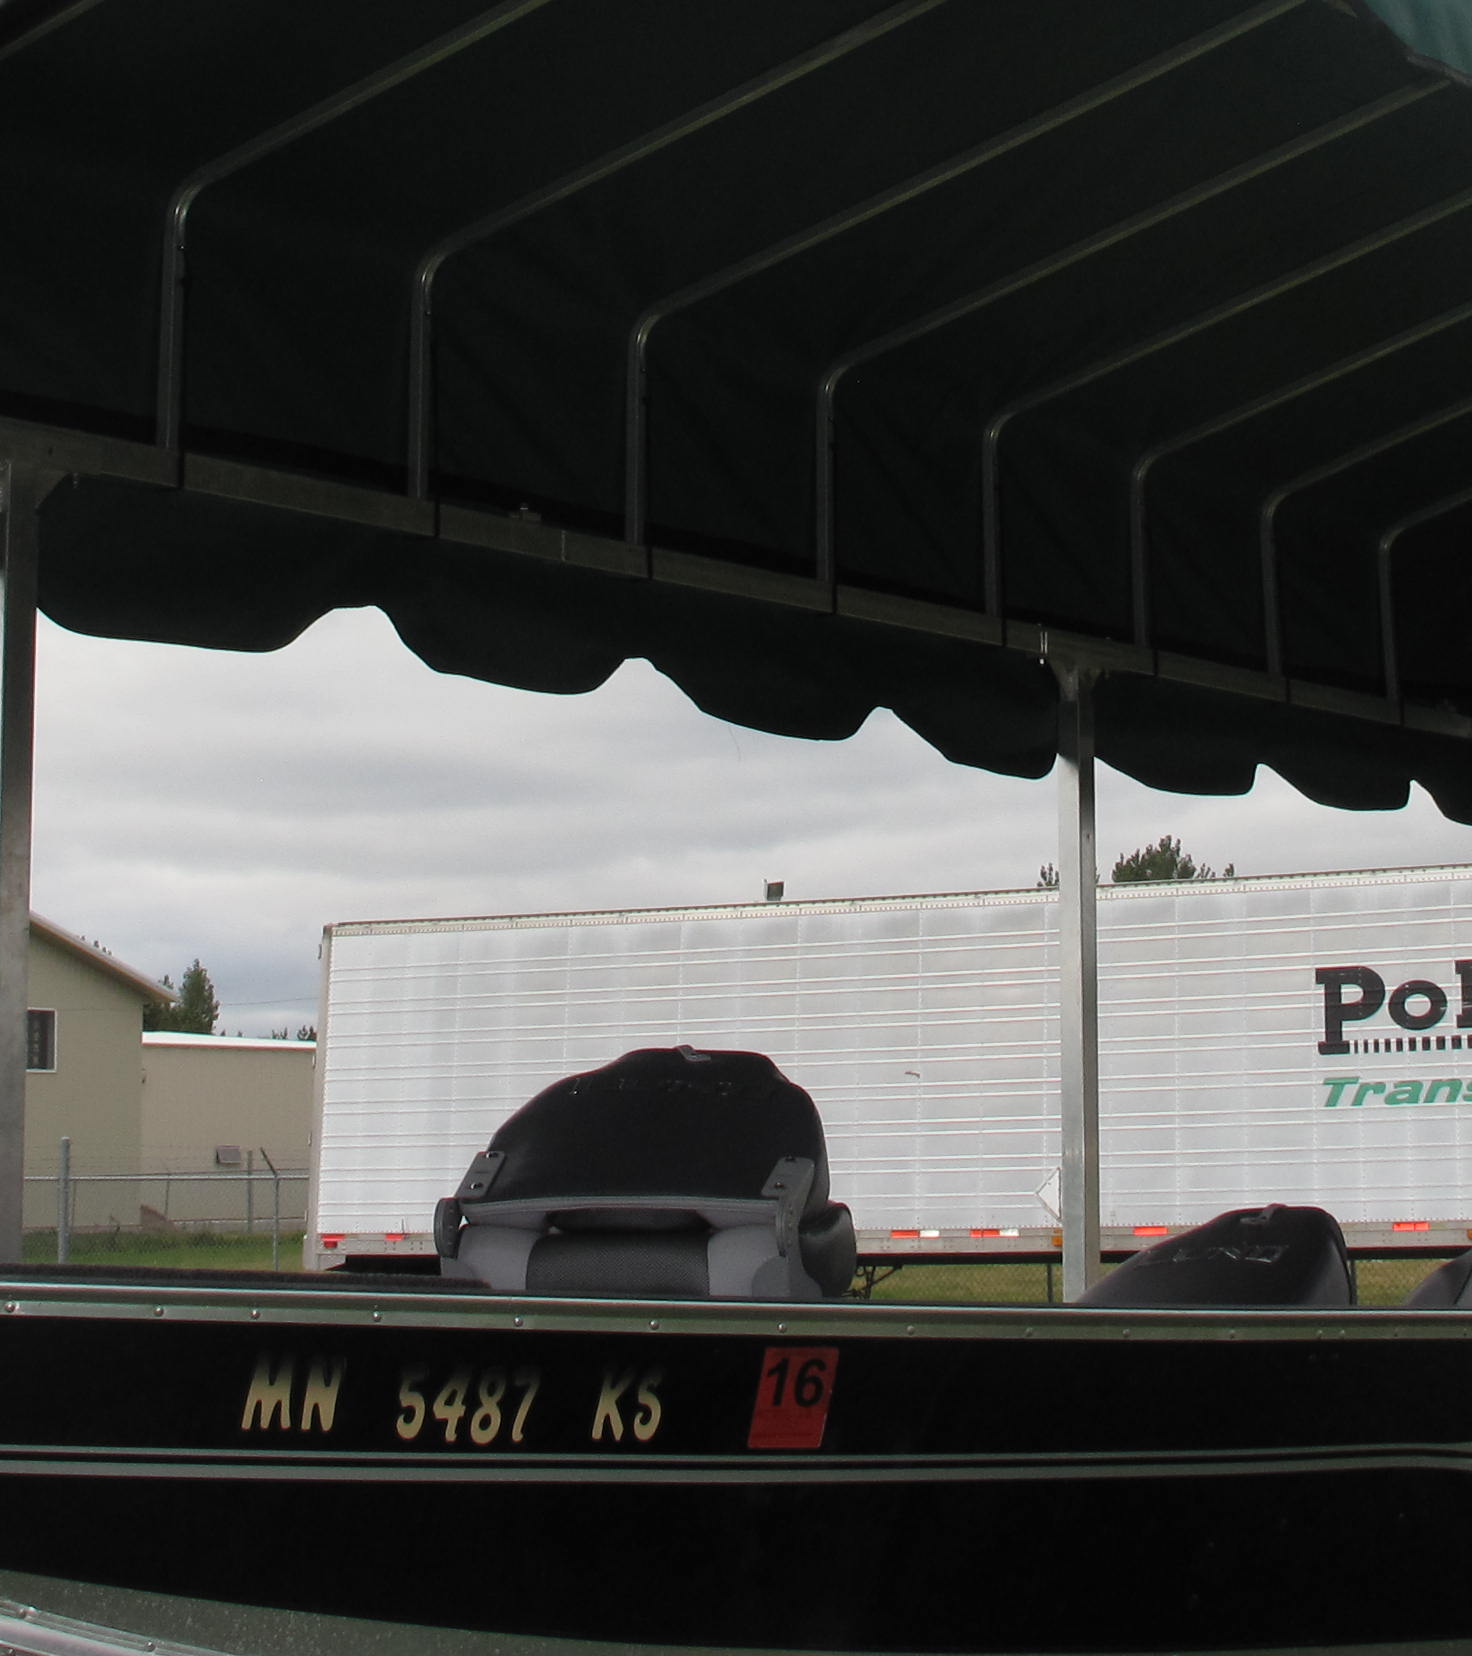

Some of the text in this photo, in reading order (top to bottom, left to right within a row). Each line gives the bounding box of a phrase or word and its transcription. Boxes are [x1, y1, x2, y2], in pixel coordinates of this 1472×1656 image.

[241, 1352, 346, 1432] MN
[394, 1363, 541, 1445] 5487
[591, 1364, 665, 1442] KS
[767, 1357, 827, 1408] 16
